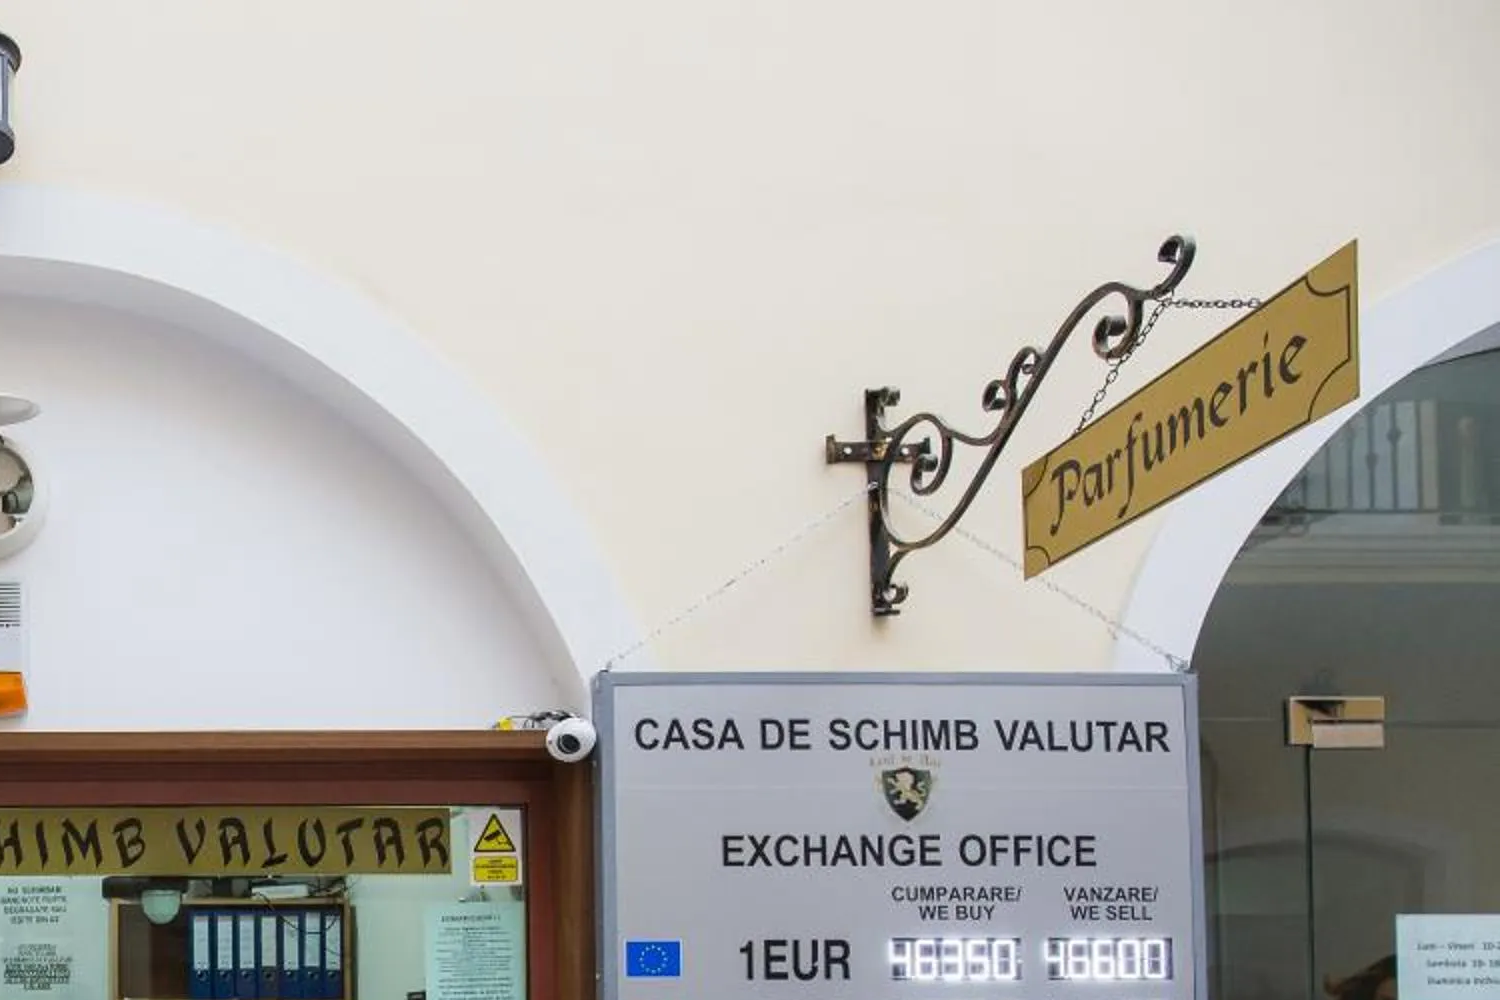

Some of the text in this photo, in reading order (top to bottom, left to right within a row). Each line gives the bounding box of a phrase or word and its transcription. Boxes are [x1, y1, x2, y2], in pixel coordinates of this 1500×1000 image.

[1050, 330, 1308, 536] Parfumerie
[634, 718, 1171, 753] CASA DE SCHIMB VALUTAR
[176, 817, 450, 871] VALUTAR
[721, 834, 1098, 867] EXCHANGE OFFICE
[891, 886, 1022, 903] CUMPARARE/
[1063, 886, 1159, 903] VANZARE/
[918, 905, 996, 921] WE BUY
[1070, 905, 1154, 922] WE SELL
[739, 939, 852, 982] 1EUR
